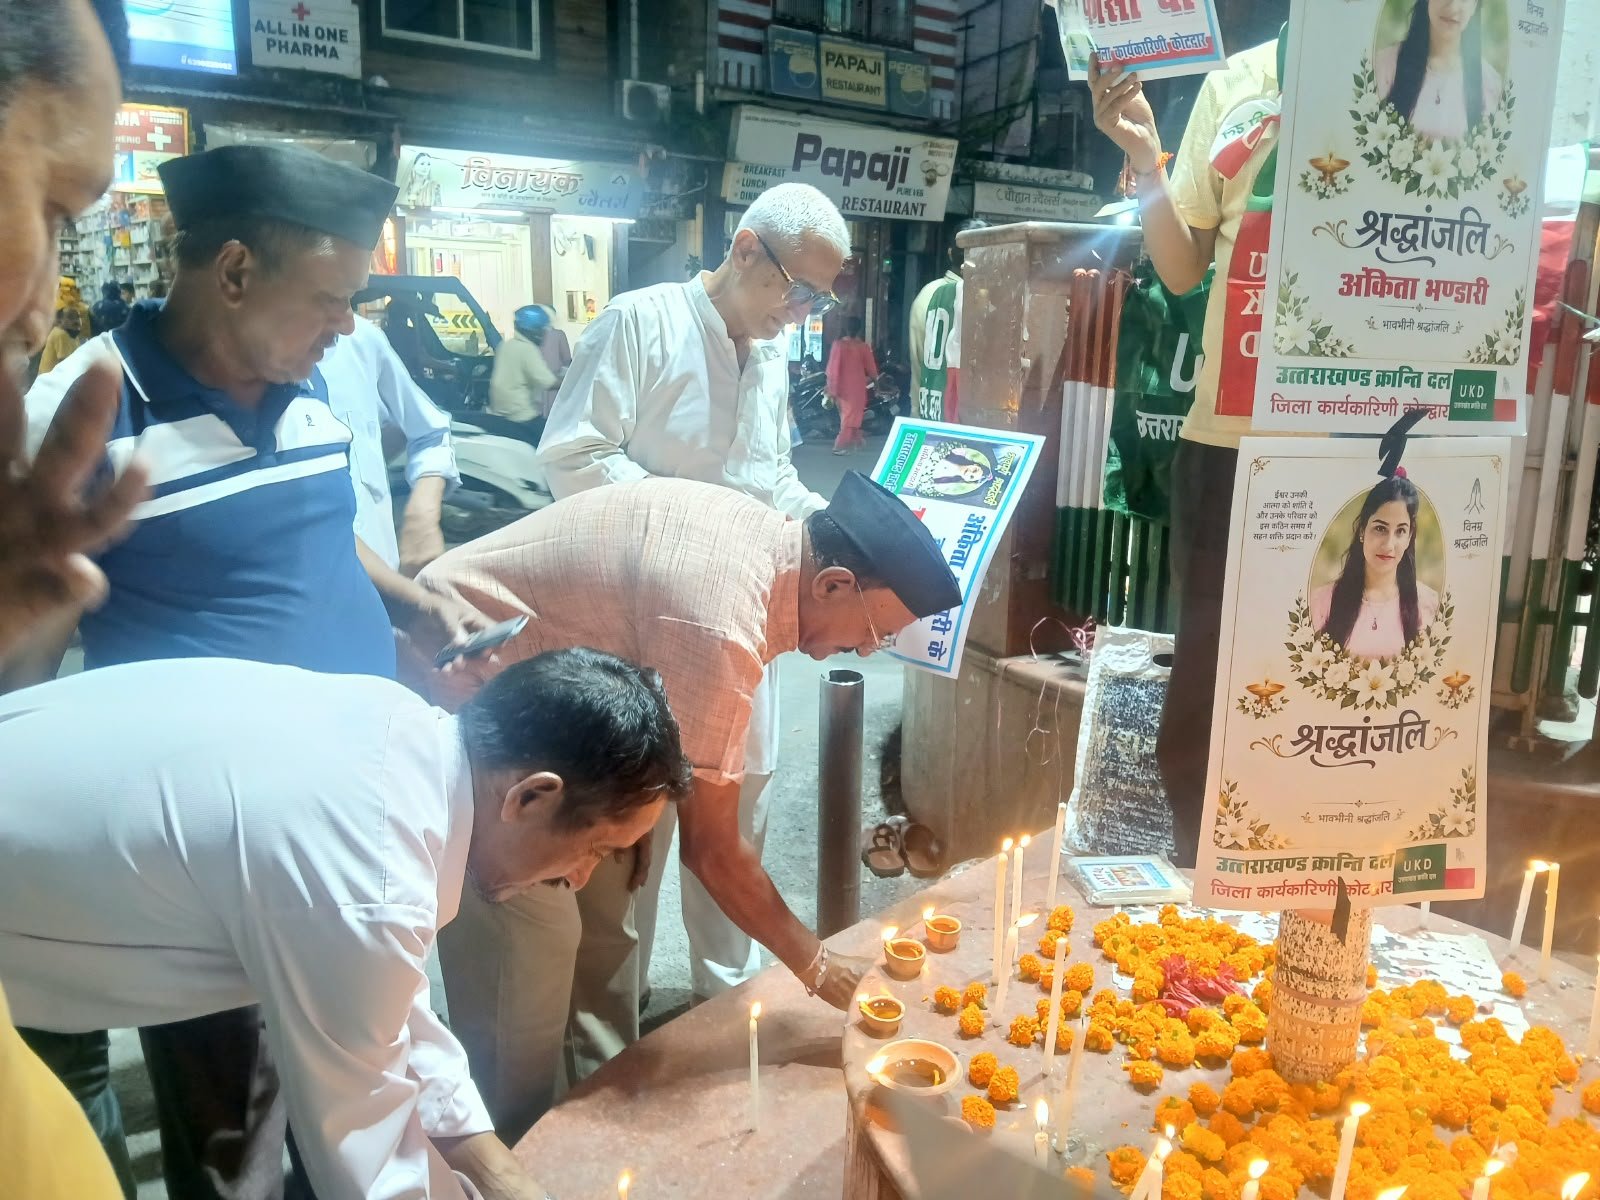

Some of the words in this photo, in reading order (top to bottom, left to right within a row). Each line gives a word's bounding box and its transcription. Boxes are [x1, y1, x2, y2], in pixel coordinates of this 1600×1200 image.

[255, 19, 287, 36] ALL
[292, 23, 310, 39] IN
[315, 26, 349, 43] ONE
[266, 37, 339, 60] PHARMA
[1113, 35, 1168, 60] कार्यकारिणी
[1170, 32, 1208, 52] कोटद्वार
[825, 51, 881, 76] PAPAJI
[826, 78, 881, 96] RESTAURANT
[743, 164, 787, 178] BREAKFAST
[792, 132, 913, 191] Papaji
[741, 178, 767, 188] LUNCH
[841, 196, 928, 217] RESTAURANT
[1355, 204, 1491, 262] श्रद्धांजलि
[1338, 266, 1420, 301] अंकिता
[1425, 276, 1490, 306] भण्डारी
[1383, 318, 1415, 331] भावभीनी
[1416, 320, 1449, 333] श्रद्धांजलि
[1276, 366, 1373, 387] उत्तराखण्ड
[1374, 366, 1424, 389] क्रान्ति
[1427, 372, 1454, 390] दल
[1460, 384, 1485, 398] UKD
[1270, 392, 1312, 415] जिला
[1317, 394, 1399, 417] कार्यकारिणी
[1274, 489, 1289, 499] ईश्वर
[1290, 490, 1308, 499] उनकी
[1255, 510, 1269, 519] और
[1269, 510, 1286, 519] उनके
[1287, 510, 1308, 519] परिवार
[1308, 510, 1318, 519] को
[1262, 502, 1281, 510] आत्मा
[1281, 500, 1291, 509] को
[1271, 521, 1289, 530] कठिन
[1463, 519, 1484, 532] विनम्र
[949, 512, 986, 570] अंकिता
[1253, 533, 1268, 541] सहन
[1269, 531, 1285, 540] शक्ति
[1454, 533, 1488, 550] श्रद्धांजलि
[927, 640, 948, 660] के
[1290, 709, 1431, 762] श्रद्धांजलि
[1318, 811, 1354, 823] भावभीनी
[1216, 855, 1309, 875] उत्तराखण्ड
[1312, 852, 1366, 874] क्रान्ति
[1369, 853, 1396, 871] दल
[1403, 858, 1432, 872] UKD
[1210, 878, 1251, 899] जिला
[1257, 878, 1340, 898] कार्यकारिणी
